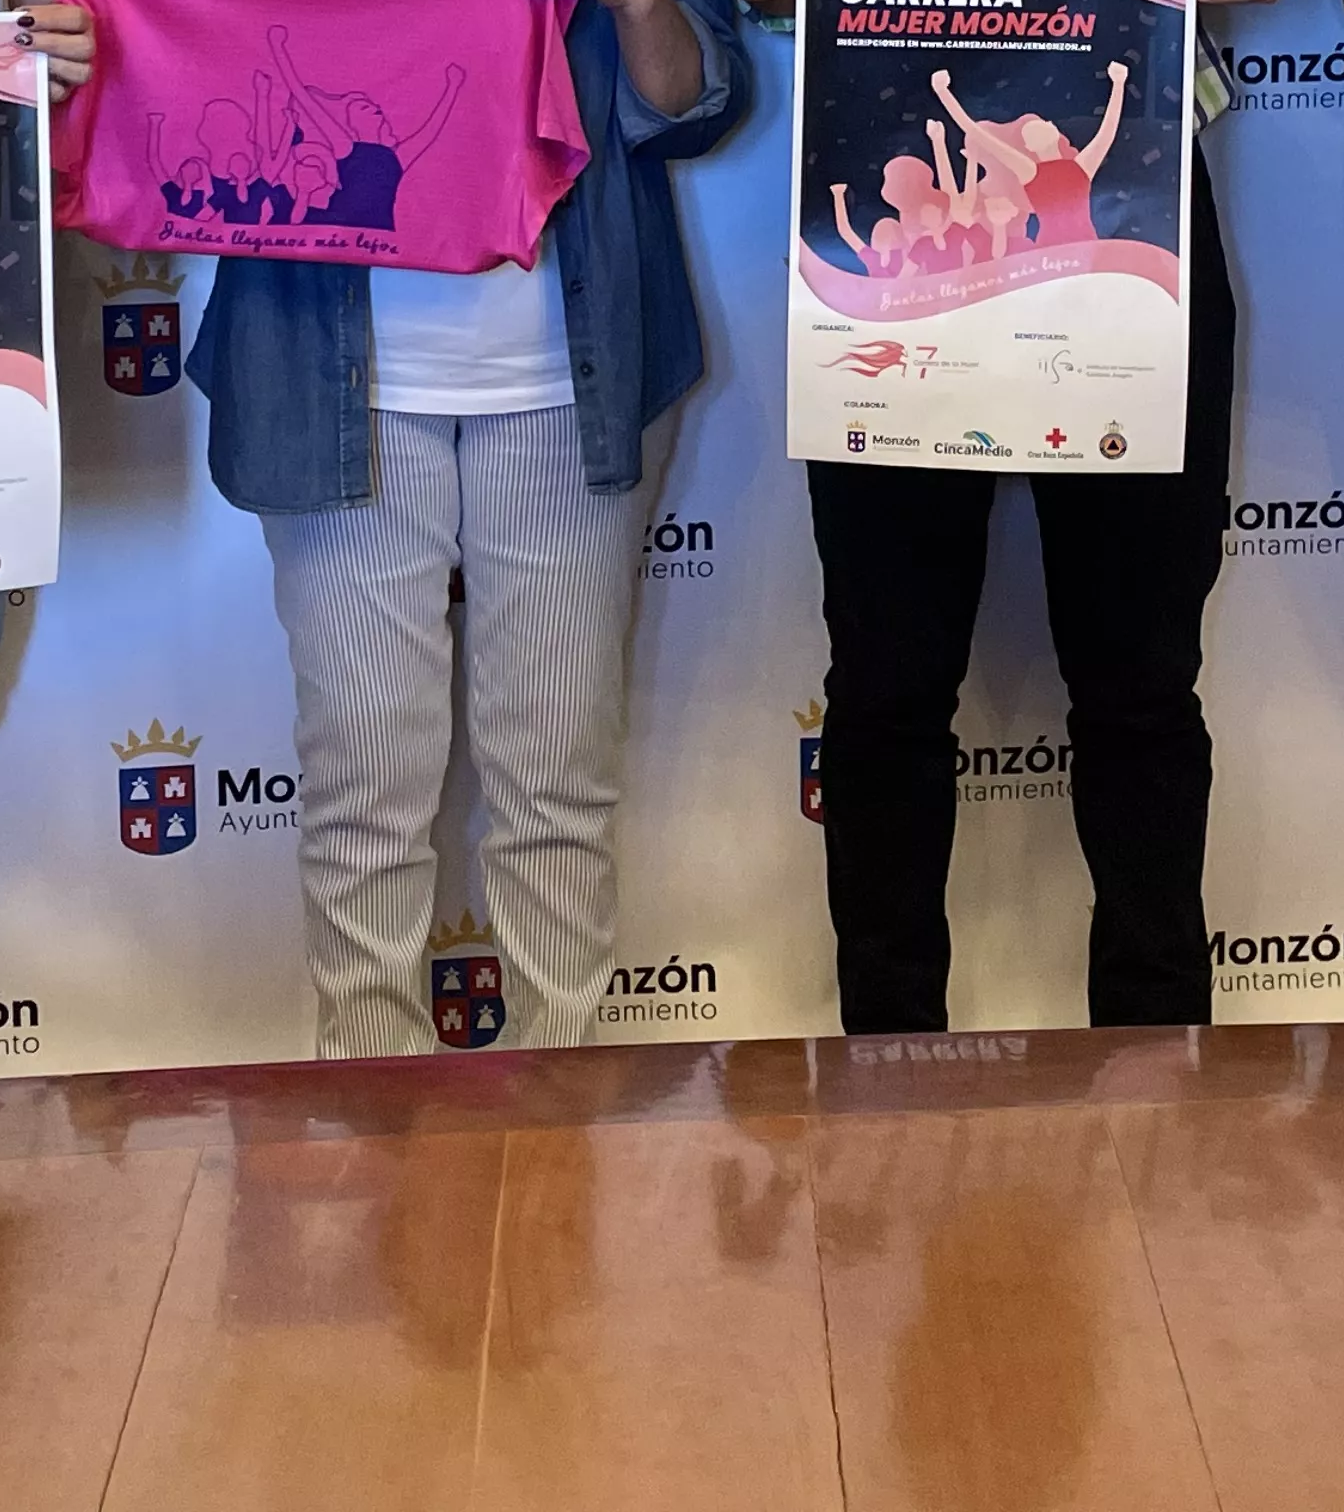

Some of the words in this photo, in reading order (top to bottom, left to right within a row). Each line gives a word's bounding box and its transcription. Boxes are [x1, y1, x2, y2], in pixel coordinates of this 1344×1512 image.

[837, 8, 946, 35] MUJER
[950, 4, 1096, 38] MONZÓN
[837, 38, 905, 48] INSCRIPCIONES
[908, 40, 918, 48] EN
[158, 220, 224, 243] Juntas
[231, 229, 307, 253] llegamos
[314, 233, 349, 248] más
[355, 232, 399, 254] lejos
[872, 435, 920, 447] Monzón
[934, 441, 1013, 458] CincaMedio
[606, 955, 717, 996] nzón
[598, 1000, 717, 1022] tamiento
